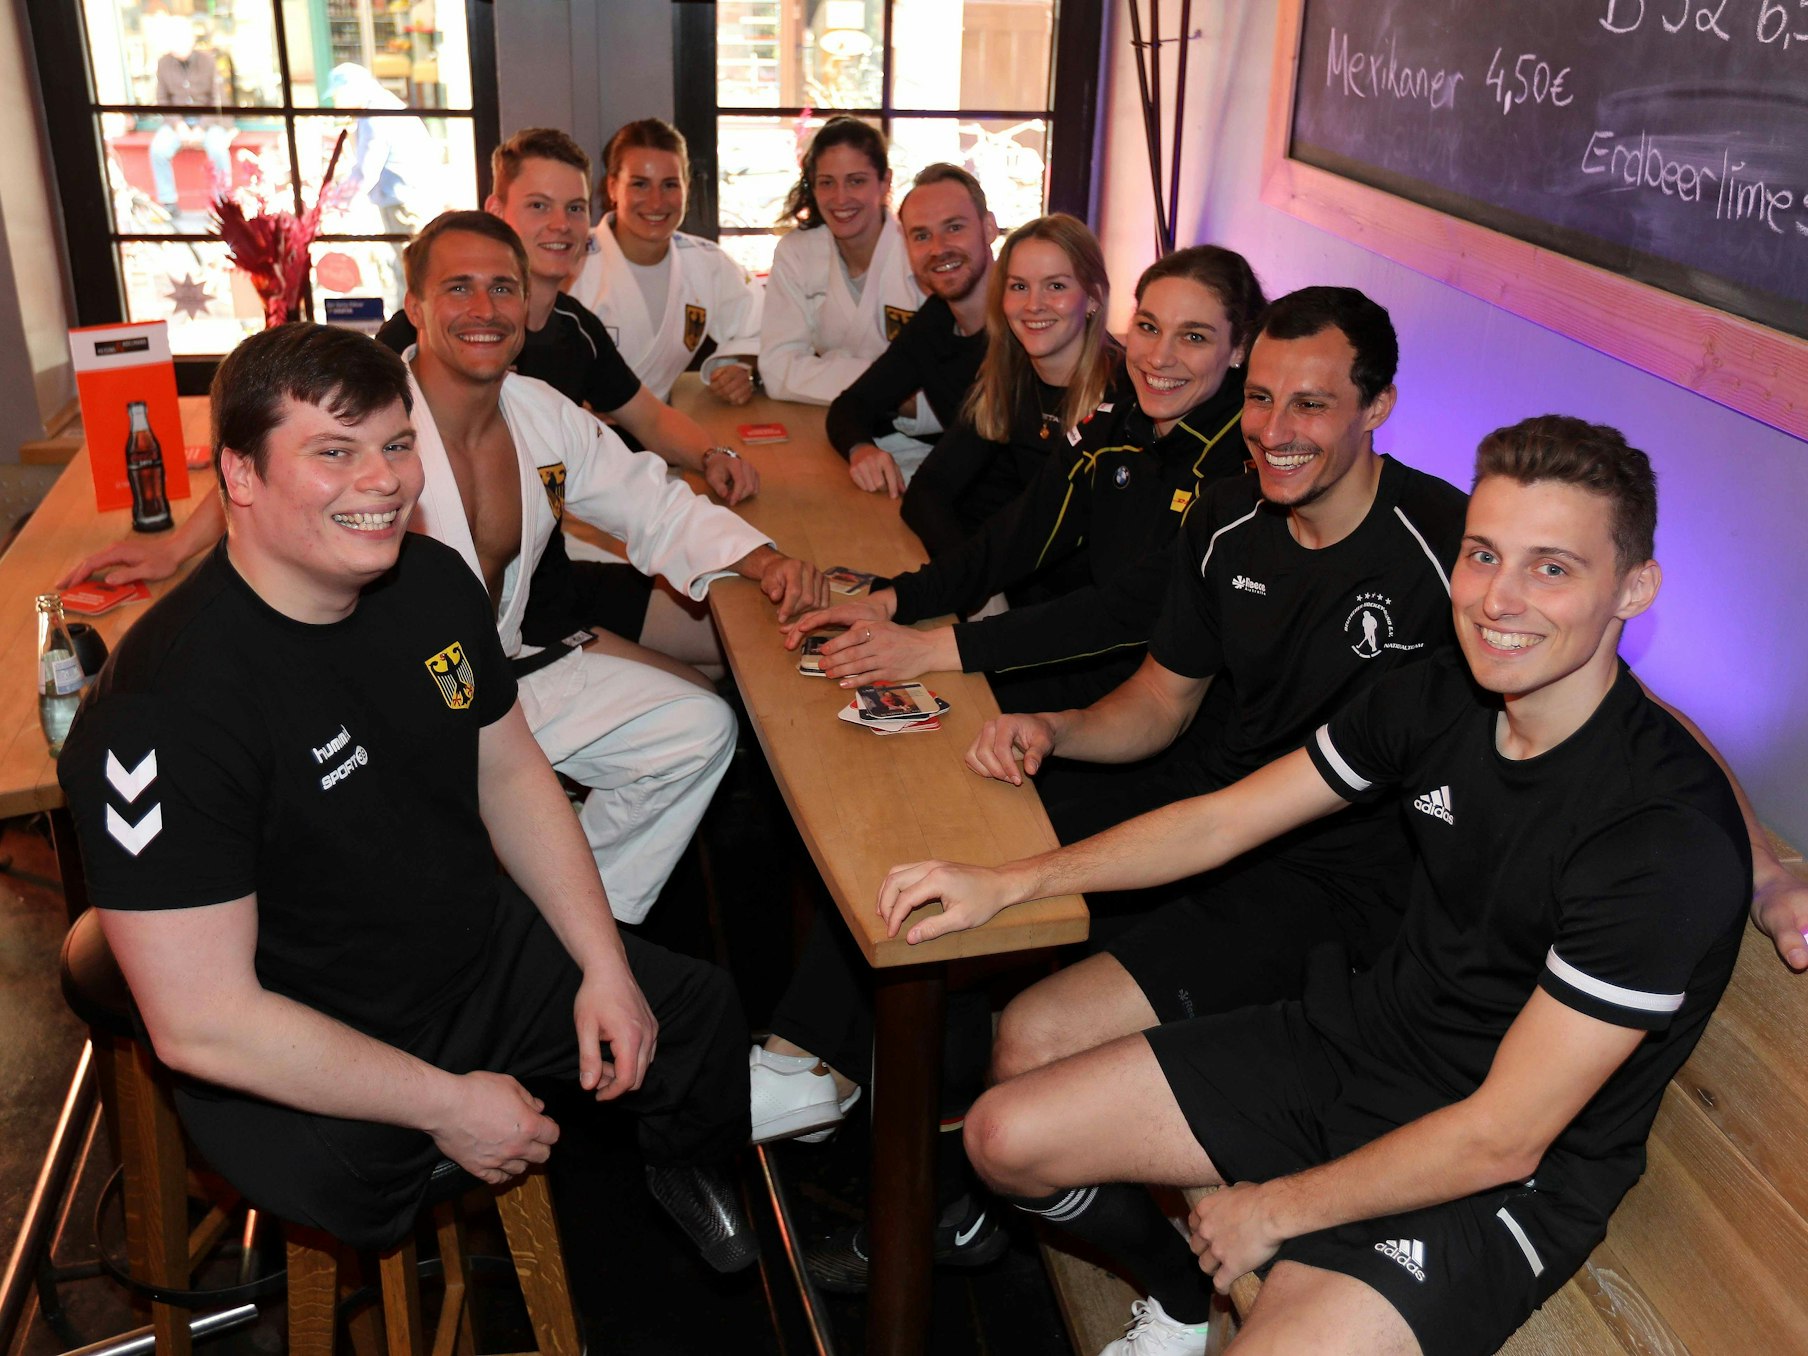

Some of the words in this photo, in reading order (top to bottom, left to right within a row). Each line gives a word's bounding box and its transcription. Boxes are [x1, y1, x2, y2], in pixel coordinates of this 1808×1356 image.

[1485, 46, 1574, 116] 4,50€
[312, 724, 352, 764] humml
[1413, 799, 1454, 826] adidas
[1374, 1242, 1426, 1282] adidas
